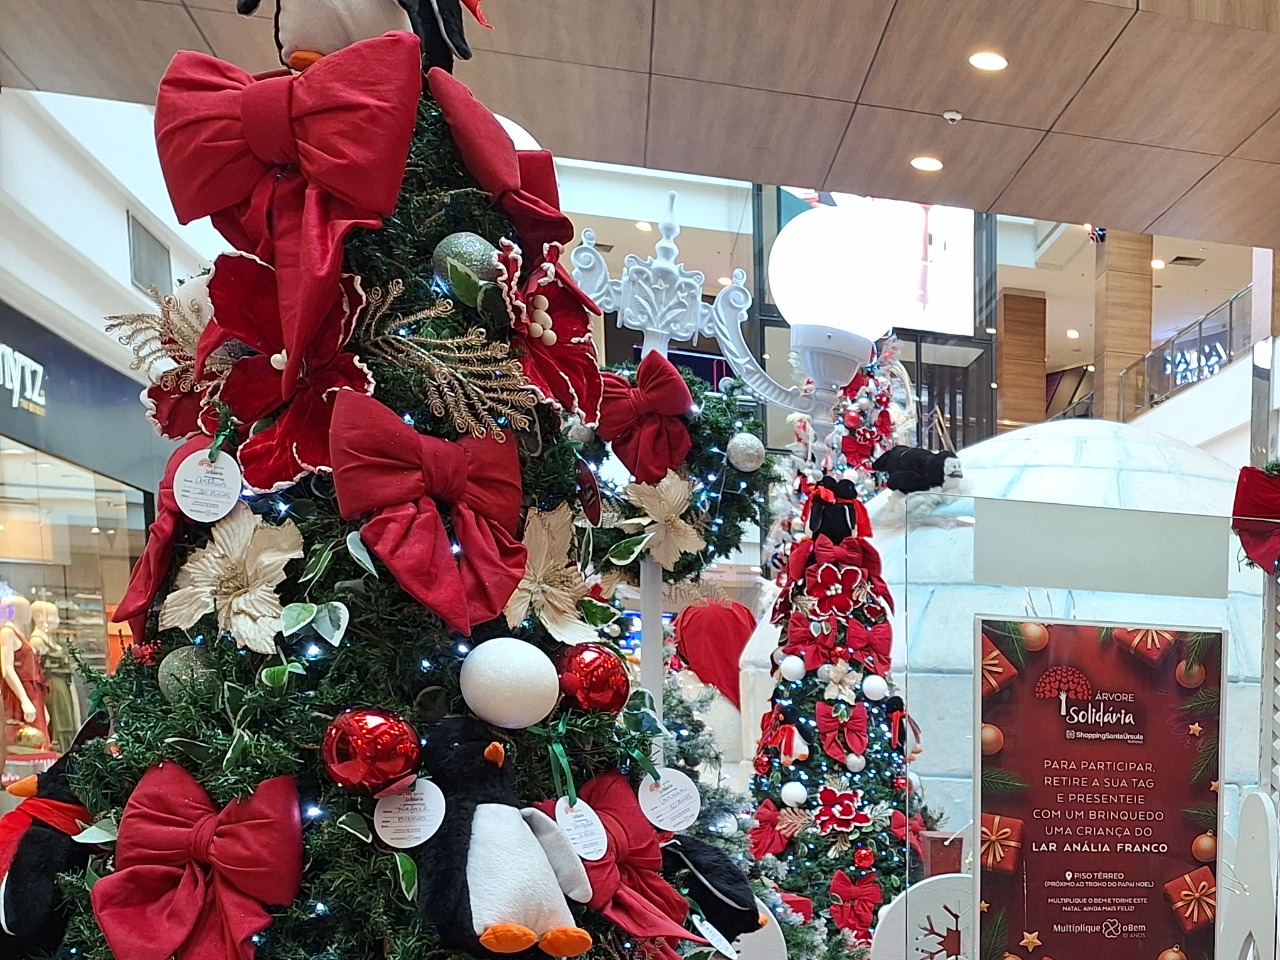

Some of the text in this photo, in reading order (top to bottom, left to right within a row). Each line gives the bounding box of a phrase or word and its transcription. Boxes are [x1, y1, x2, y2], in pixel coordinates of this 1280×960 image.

[1095, 690, 1135, 702] ÁRVORE
[1066, 701, 1135, 727] Solidária
[1044, 760, 1156, 773] PARA PARTICIPAR,
[1044, 776, 1155, 788] RETIRE A SUA TAG
[1057, 794, 1145, 804] E PRESENTEIE
[1033, 809, 1164, 821] COM UM BRINQUEDO
[1045, 826, 1153, 838] UMA CRIANÇA DO
[1032, 840, 1168, 853] LAR ANÁLIA FRANCO
[1074, 871, 1125, 880] PISO TÉRREO
[1044, 880, 1075, 888] (PRÓXIMO
